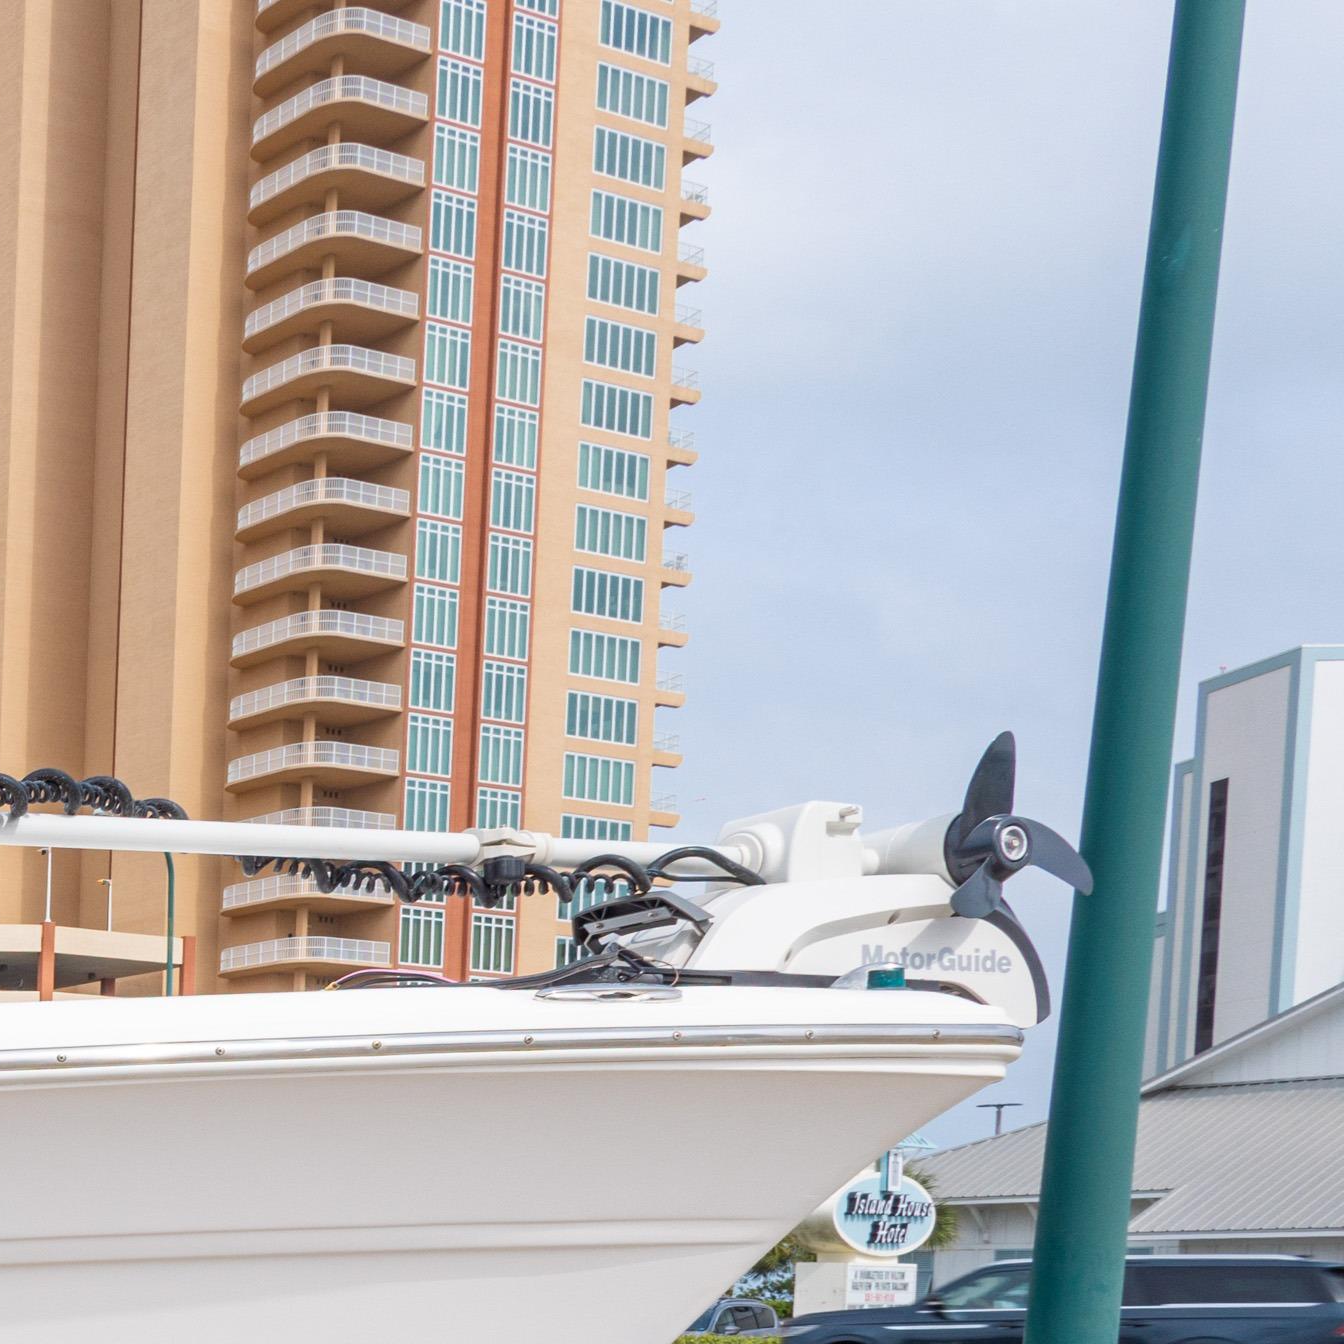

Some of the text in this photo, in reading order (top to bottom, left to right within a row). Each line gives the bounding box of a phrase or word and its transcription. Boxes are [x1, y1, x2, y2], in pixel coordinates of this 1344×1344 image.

[861, 944, 1012, 973] MotorGuide
[852, 1191, 895, 1215] Island
[874, 1220, 910, 1243] Hotel
